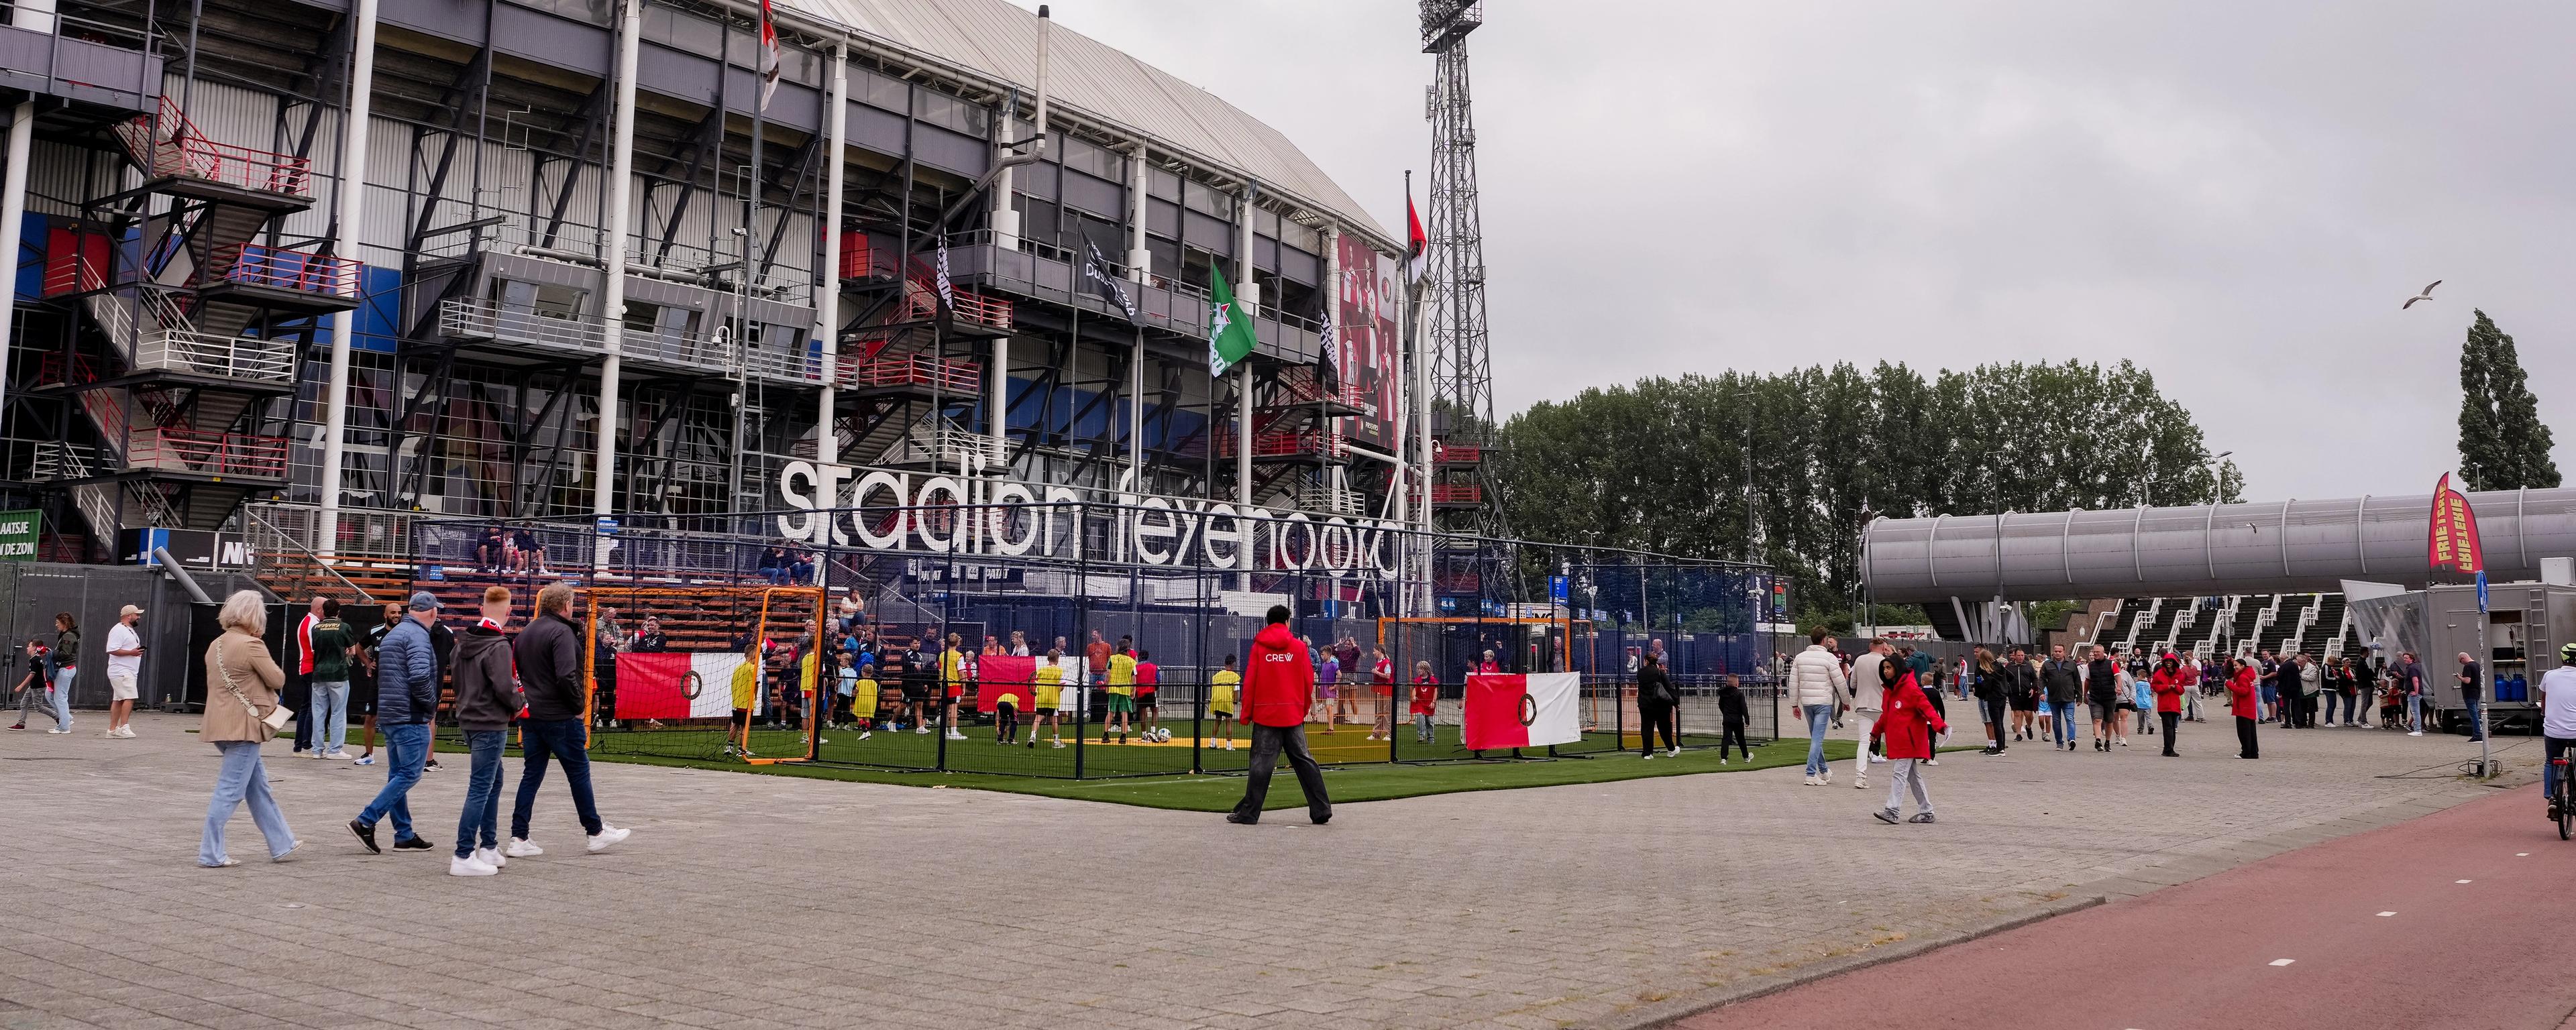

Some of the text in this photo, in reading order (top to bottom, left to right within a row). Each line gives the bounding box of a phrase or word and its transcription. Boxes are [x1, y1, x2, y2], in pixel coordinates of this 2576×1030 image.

[777, 451, 1405, 579] stadion feyenoord
[0, 521, 29, 534] AATSJE
[5, 543, 16, 555] DE
[16, 542, 34, 555] ZON
[921, 570, 942, 581] PATAT
[986, 568, 1010, 579] PATAT
[1265, 653, 1293, 662] CREW
